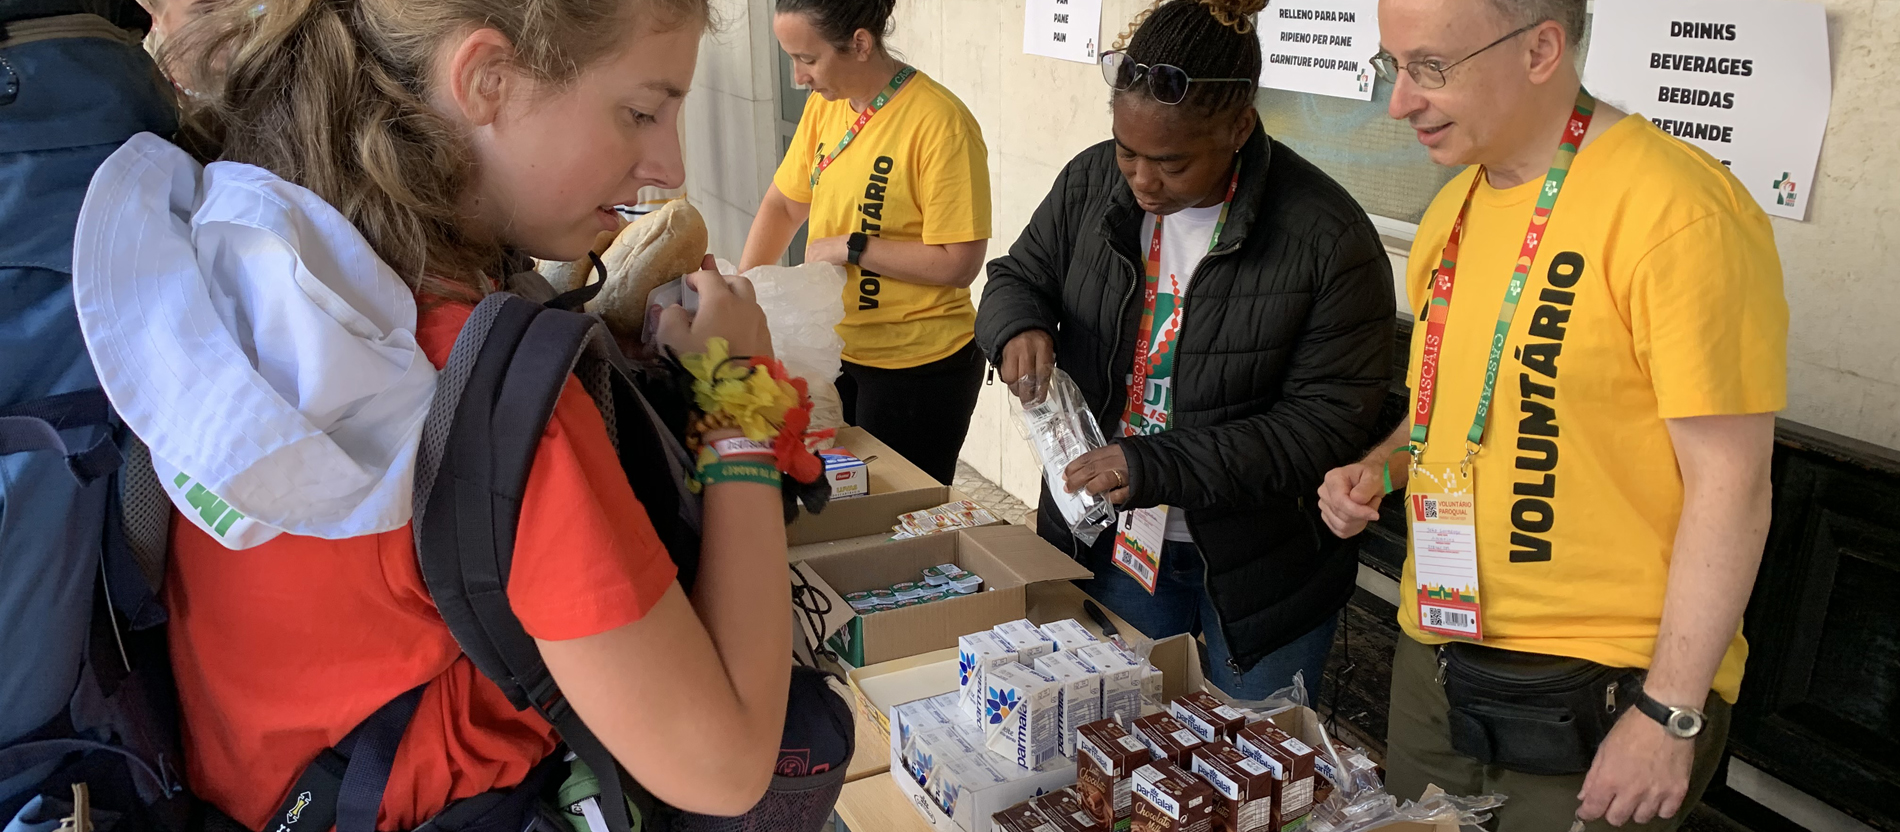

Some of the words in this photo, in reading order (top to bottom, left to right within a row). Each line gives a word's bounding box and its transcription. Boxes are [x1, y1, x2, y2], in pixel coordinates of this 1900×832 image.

[1053, 13, 1069, 24] PANE
[1279, 8, 1313, 20] RELLENO
[1315, 10, 1337, 22] PARA
[1338, 12, 1355, 23] PAN
[1053, 32, 1067, 43] PAIN
[1280, 31, 1311, 44] RIPIENO
[1312, 34, 1328, 45] PER
[1329, 35, 1352, 47] PANE
[1670, 21, 1736, 41] DRINKS
[1270, 53, 1312, 67] GARNITURE
[1313, 58, 1336, 70] POUR
[1337, 60, 1358, 72] PAIN
[1650, 52, 1753, 77] BEVERAGES
[1658, 86, 1735, 109] BEBIDAS
[858, 155, 894, 311] VOLTÁRIO
[1132, 340, 1148, 405] CASCAIS
[1417, 334, 1440, 414] CASCAIS
[1477, 333, 1504, 417] CASCAIS
[1509, 251, 1585, 563] VOLUNTÁRIO
[1176, 710, 1209, 739] parmalat
[1081, 740, 1108, 772] parmalat
[1197, 764, 1232, 796] parmalat
[1136, 782, 1174, 815] parmalat
[1135, 801, 1172, 829] Chocolate
